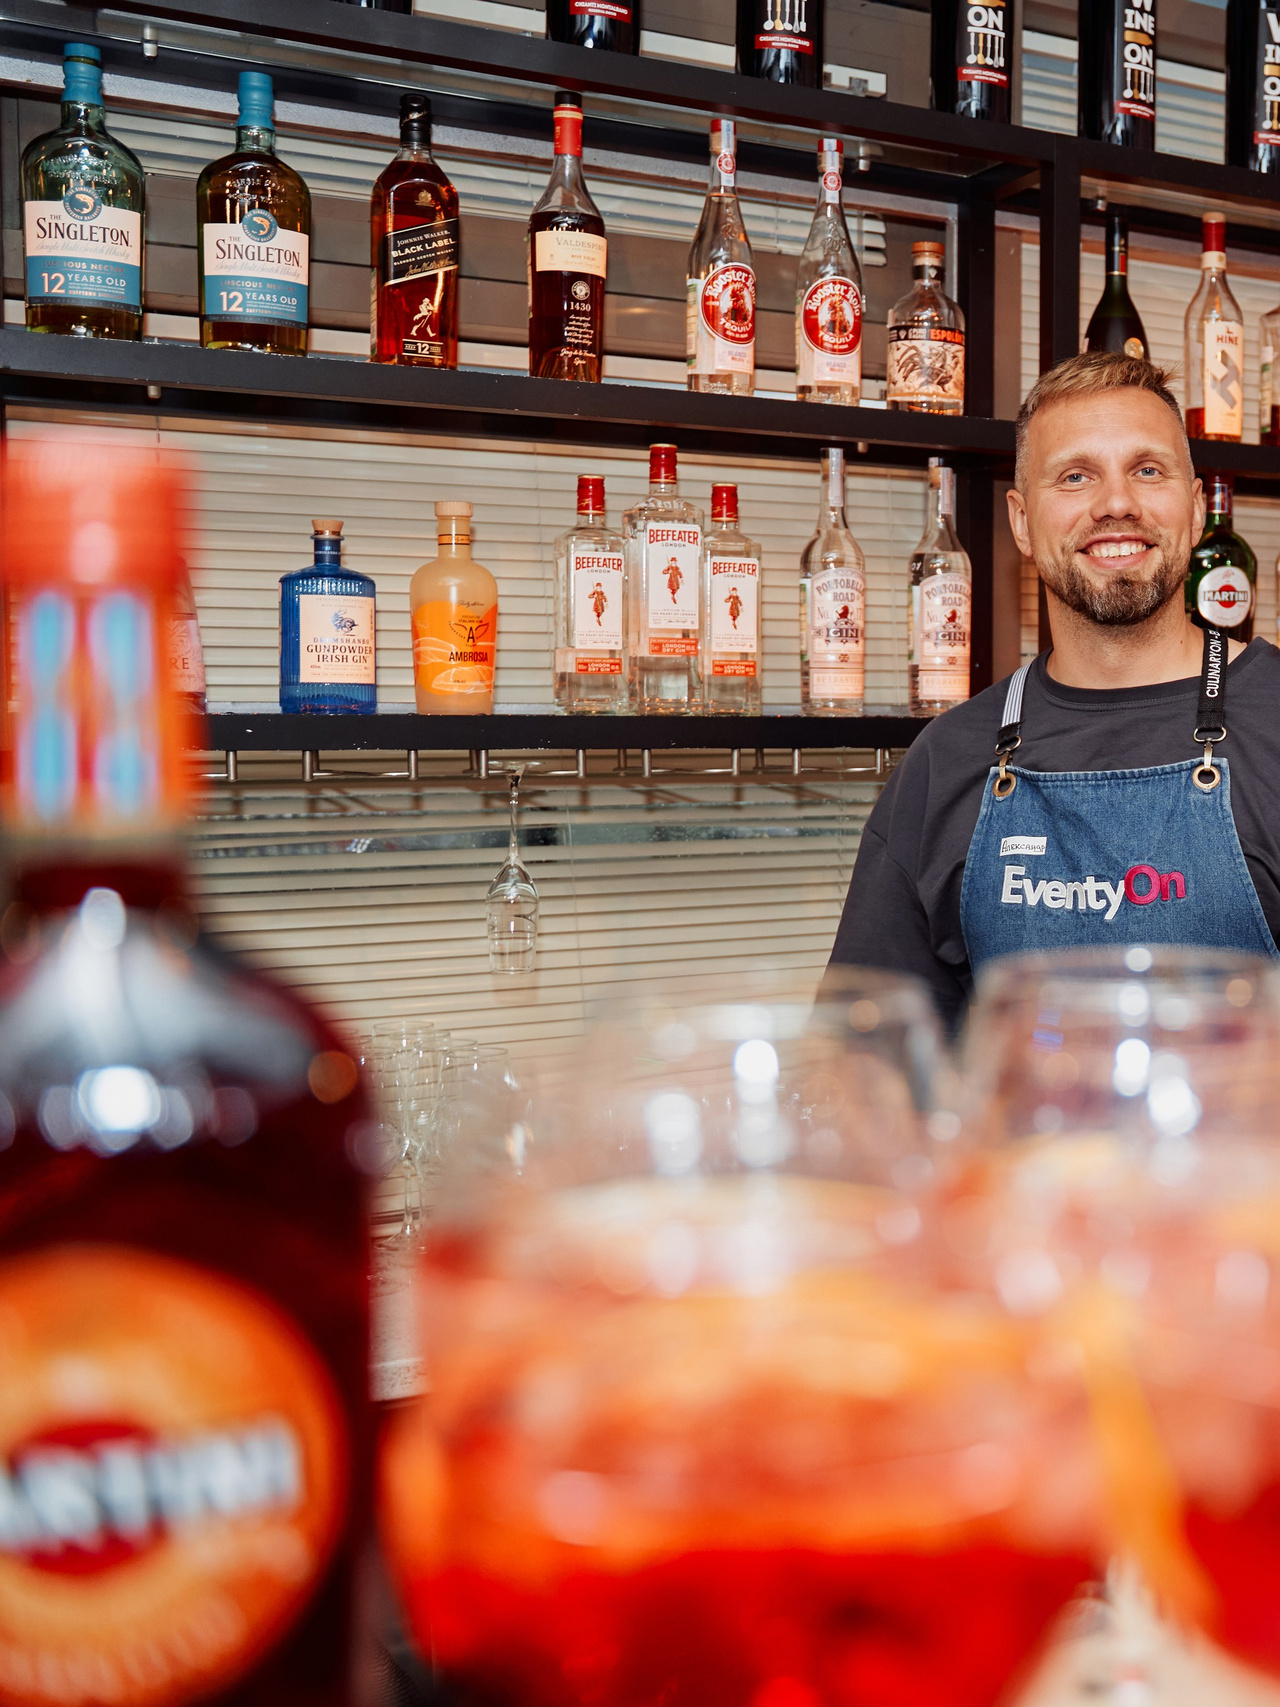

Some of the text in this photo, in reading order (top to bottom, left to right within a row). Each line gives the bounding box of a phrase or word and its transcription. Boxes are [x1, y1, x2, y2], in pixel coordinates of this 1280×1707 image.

[967, 5, 1004, 31] ON
[1123, 8, 1155, 36] INE
[1123, 42, 1154, 68] ON
[36, 217, 130, 248] SINGLETON
[396, 230, 449, 247] JOHNNIE WALKER
[215, 238, 301, 267] SINGLETON
[391, 237, 456, 258] BLACK LABEL
[42, 260, 87, 270] LUSCIOUS
[41, 272, 66, 294] 12
[67, 273, 103, 284] YEARS
[105, 277, 127, 287] OLD
[221, 280, 263, 288] LUSCIOUS
[705, 269, 748, 298] Rooster
[219, 291, 244, 312] 12
[245, 292, 278, 302] YEARS
[280, 295, 298, 305] OLD
[805, 282, 848, 312] Rooster
[569, 301, 591, 312] 1430
[720, 317, 753, 332] TEQUILA
[819, 331, 854, 343] TEQUILA
[1216, 335, 1239, 346] HINE
[416, 343, 430, 354] 12
[648, 528, 699, 546] BEEFEATER
[575, 556, 623, 572] BEEFEATER
[712, 561, 757, 577] BEEFEATER
[815, 578, 865, 596] PORTOBELL
[925, 583, 971, 599] PORTOBELL
[833, 592, 856, 602] ROAD
[941, 596, 963, 607] ROAD
[1204, 590, 1248, 601] MARTINI
[466, 626, 475, 643] A
[828, 628, 858, 637] GIN
[937, 631, 966, 641] GIN
[306, 644, 373, 655] GUNPOWDER
[448, 652, 489, 662] AMBROSIA
[317, 654, 368, 664] IRISH GIN
[1001, 864, 1186, 920] EventyOn
